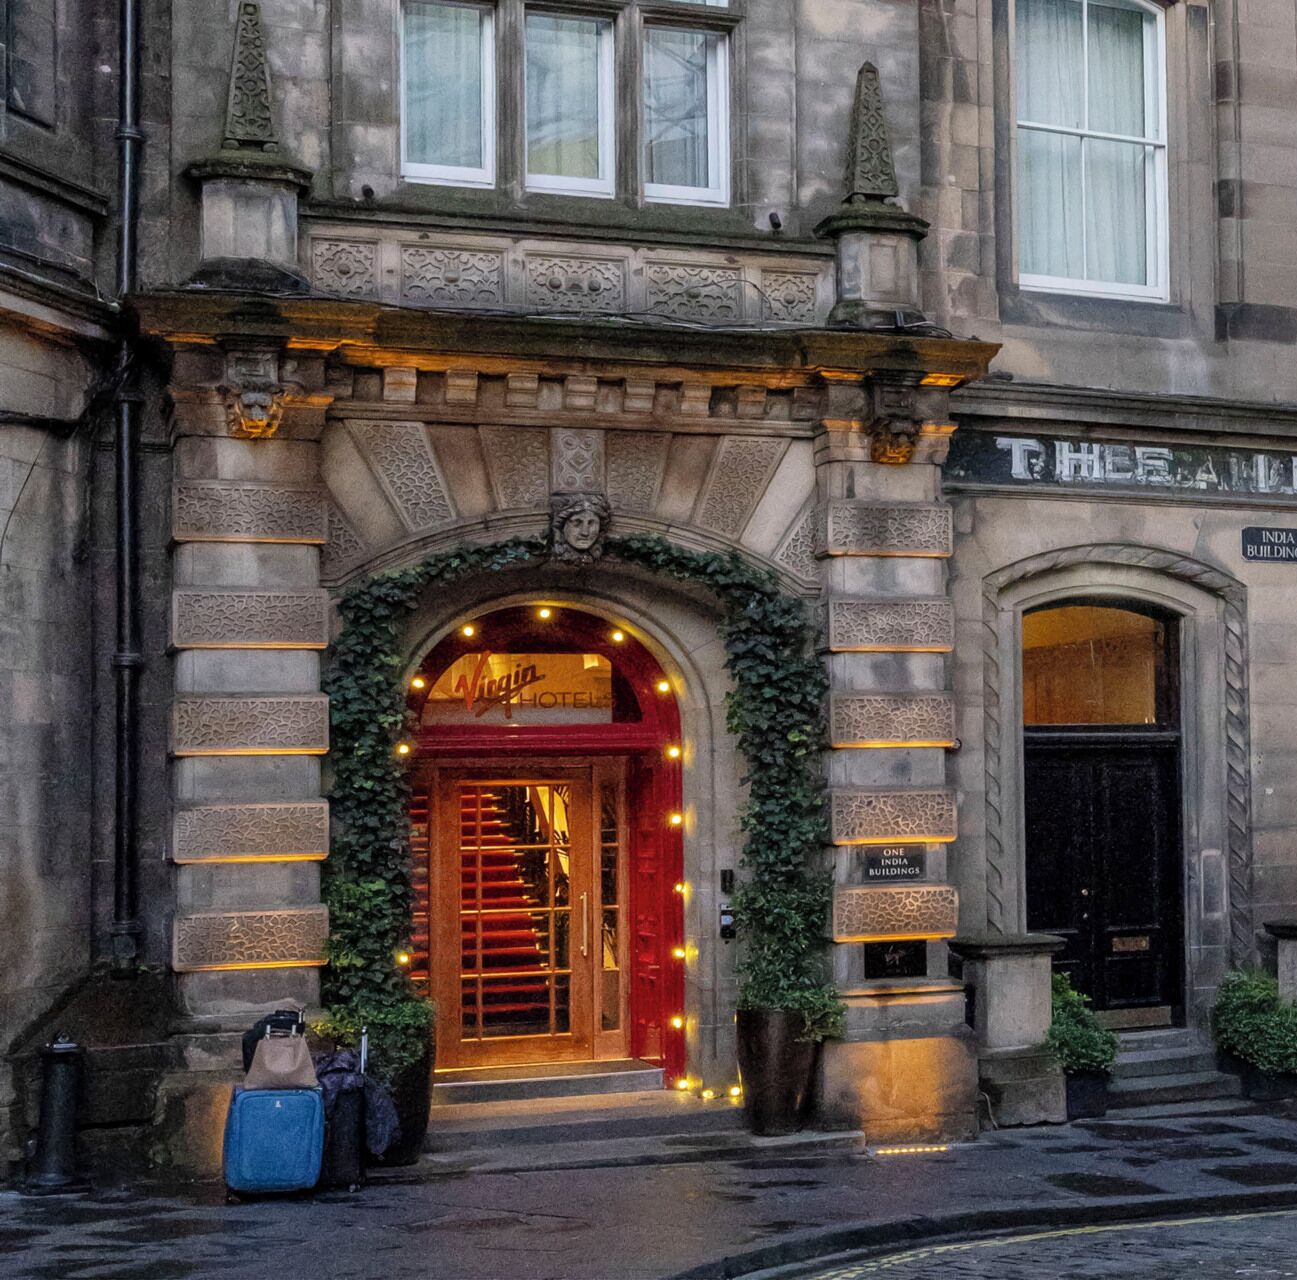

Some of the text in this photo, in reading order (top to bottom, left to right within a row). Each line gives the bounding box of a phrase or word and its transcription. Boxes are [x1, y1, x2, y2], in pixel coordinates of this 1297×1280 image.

[1261, 530, 1296, 545] INDIA
[454, 650, 546, 719] Virgin
[883, 847, 906, 857] ONE
[881, 857, 909, 867] INDIA
[869, 866, 921, 877] BUILDINGS
